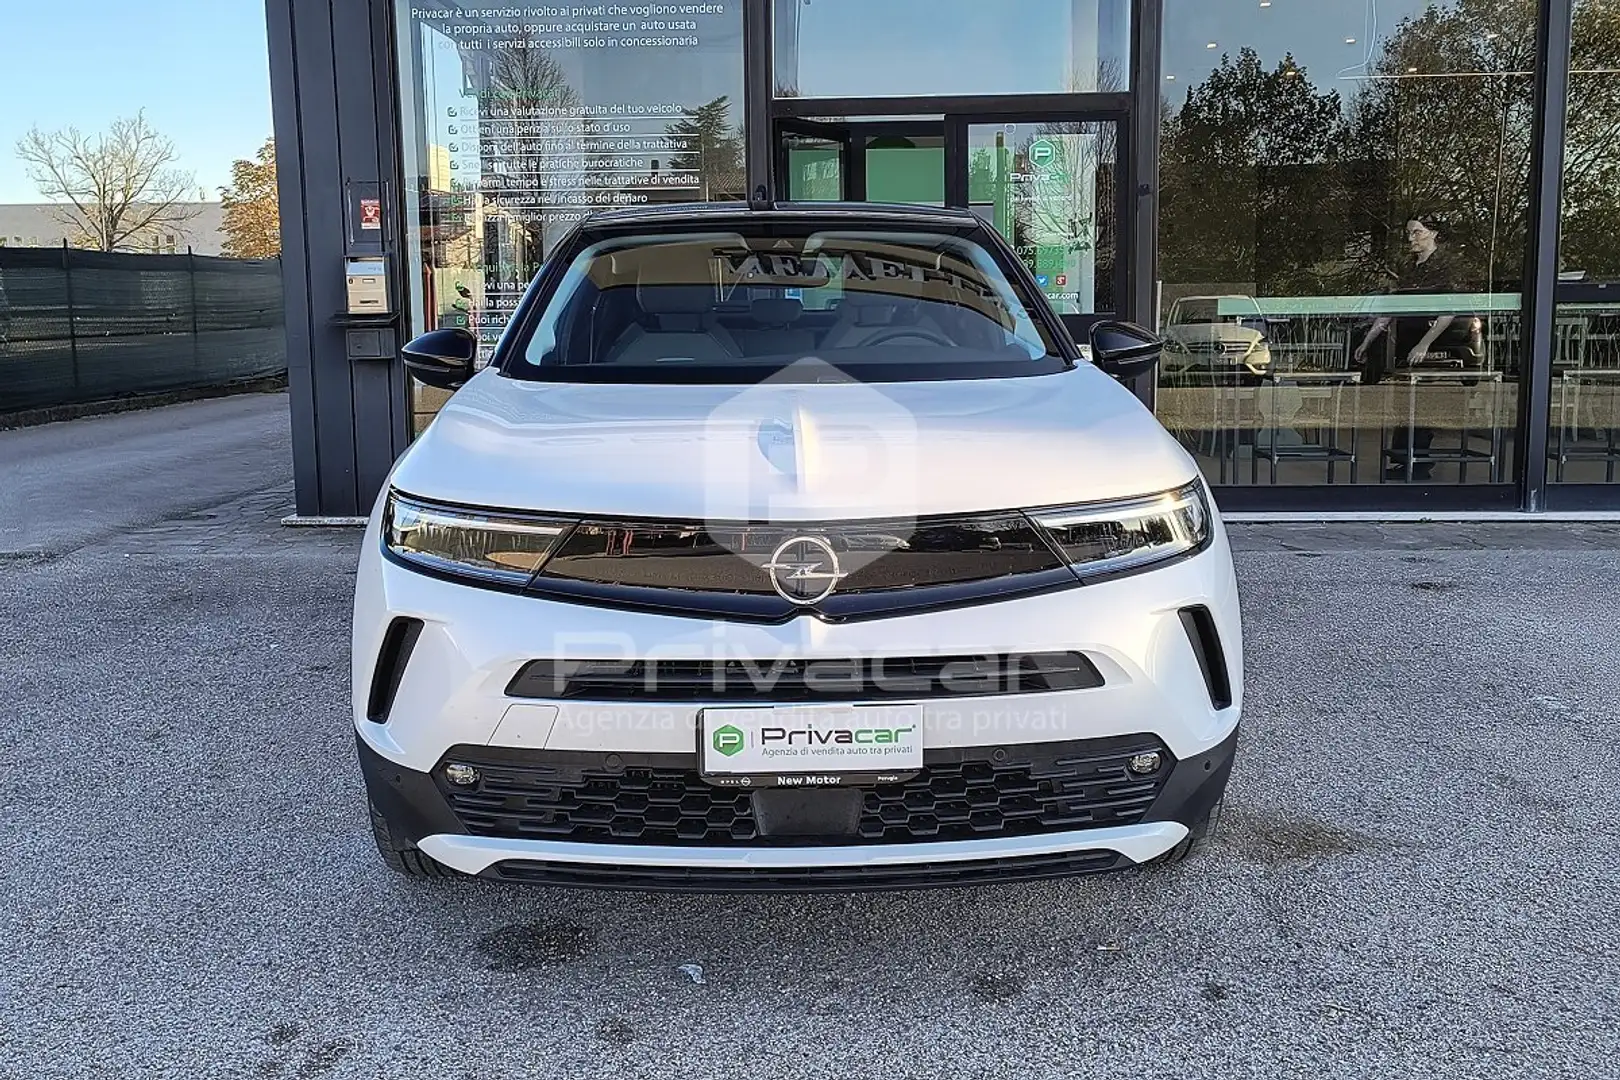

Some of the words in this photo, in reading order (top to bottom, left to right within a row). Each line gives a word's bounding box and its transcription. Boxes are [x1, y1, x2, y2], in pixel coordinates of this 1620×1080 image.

[412, 8, 453, 19] Privacar
[456, 7, 463, 18] è
[464, 10, 479, 18] un
[481, 7, 521, 18] servizio
[524, 6, 558, 17] rivolto
[560, 6, 570, 16] ai
[572, 5, 606, 18] privati
[608, 5, 628, 15] che
[629, 4, 678, 17] vogliono
[679, 3, 724, 14] vendere
[442, 23, 452, 34] la
[454, 23, 493, 36] propria
[495, 24, 522, 34] auto,
[524, 24, 562, 36] oppure
[565, 21, 620, 34] acquistare
[622, 22, 636, 31] un
[640, 20, 666, 30] auto
[668, 19, 697, 30] usata
[460, 39, 482, 50] tutti
[493, 38, 526, 49] servizi
[527, 36, 581, 49] accessibili
[583, 36, 605, 48] solo
[607, 36, 618, 47] in
[620, 35, 698, 47] concessionaria
[490, 107, 509, 116] una
[510, 106, 567, 116] valutazione
[568, 105, 608, 117] gratuita
[610, 104, 625, 114] del
[627, 104, 645, 114] tuo
[646, 102, 682, 114] veicolo
[497, 126, 514, 134] una
[576, 122, 600, 132] stato
[544, 140, 564, 151] fino
[576, 140, 615, 150] termine
[616, 139, 640, 150] della
[642, 138, 688, 150] trattativa
[540, 156, 580, 170] pratiche
[582, 157, 644, 168] burocratiche
[549, 176, 576, 187] stress
[604, 174, 649, 186] trattative
[650, 174, 660, 184] di
[662, 174, 700, 184] vendita
[491, 194, 536, 205] sicurezza
[595, 193, 610, 203] del
[612, 192, 648, 203] denaro
[549, 213, 581, 224] prezzo
[496, 282, 516, 290] una
[486, 298, 494, 308] la
[761, 724, 914, 745] Privacar
[762, 748, 798, 758] Agenzia
[800, 746, 809, 756] di
[810, 746, 846, 756] vendita
[847, 747, 868, 756] auto
[870, 747, 883, 755] tra
[884, 745, 914, 756] privati
[777, 776, 804, 786] New
[806, 775, 842, 786] Motor
